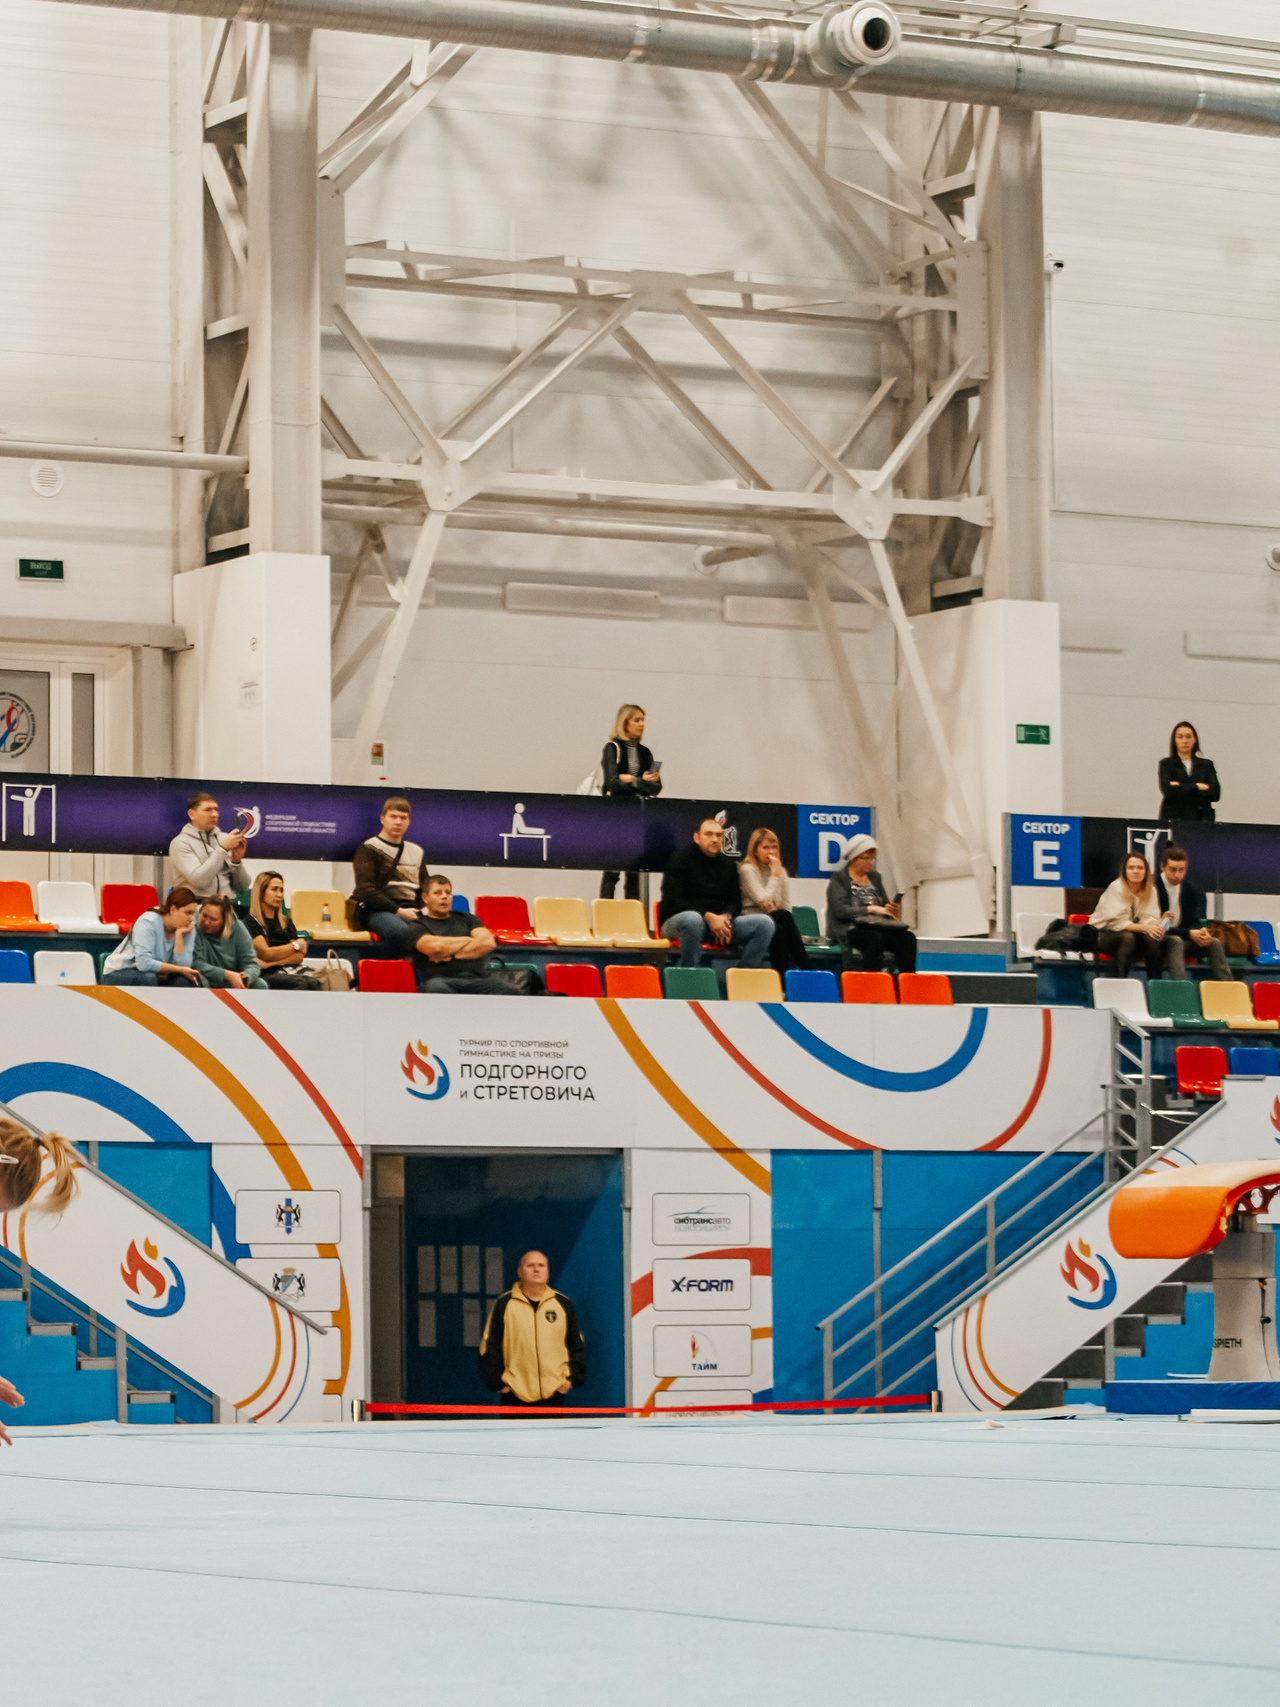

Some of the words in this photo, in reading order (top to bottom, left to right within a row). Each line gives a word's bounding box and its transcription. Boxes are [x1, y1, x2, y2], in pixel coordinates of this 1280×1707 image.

[809, 812, 860, 826] СЕКТОР
[1022, 821, 1071, 834] СЕКТОР
[818, 832, 849, 872] D
[1033, 840, 1061, 880] E
[459, 1039, 492, 1047] ТУРНИР
[510, 1040, 569, 1048] СПОРТИВНОЙ
[459, 1050, 516, 1058] ГИМНАСТИКЕ
[533, 1051, 564, 1059] ПРИЗЫ
[460, 1064, 587, 1081] ПОДГОРНОГО
[473, 1085, 595, 1101] СТРЕТОВИЧА
[671, 1276, 734, 1292] X-FORM
